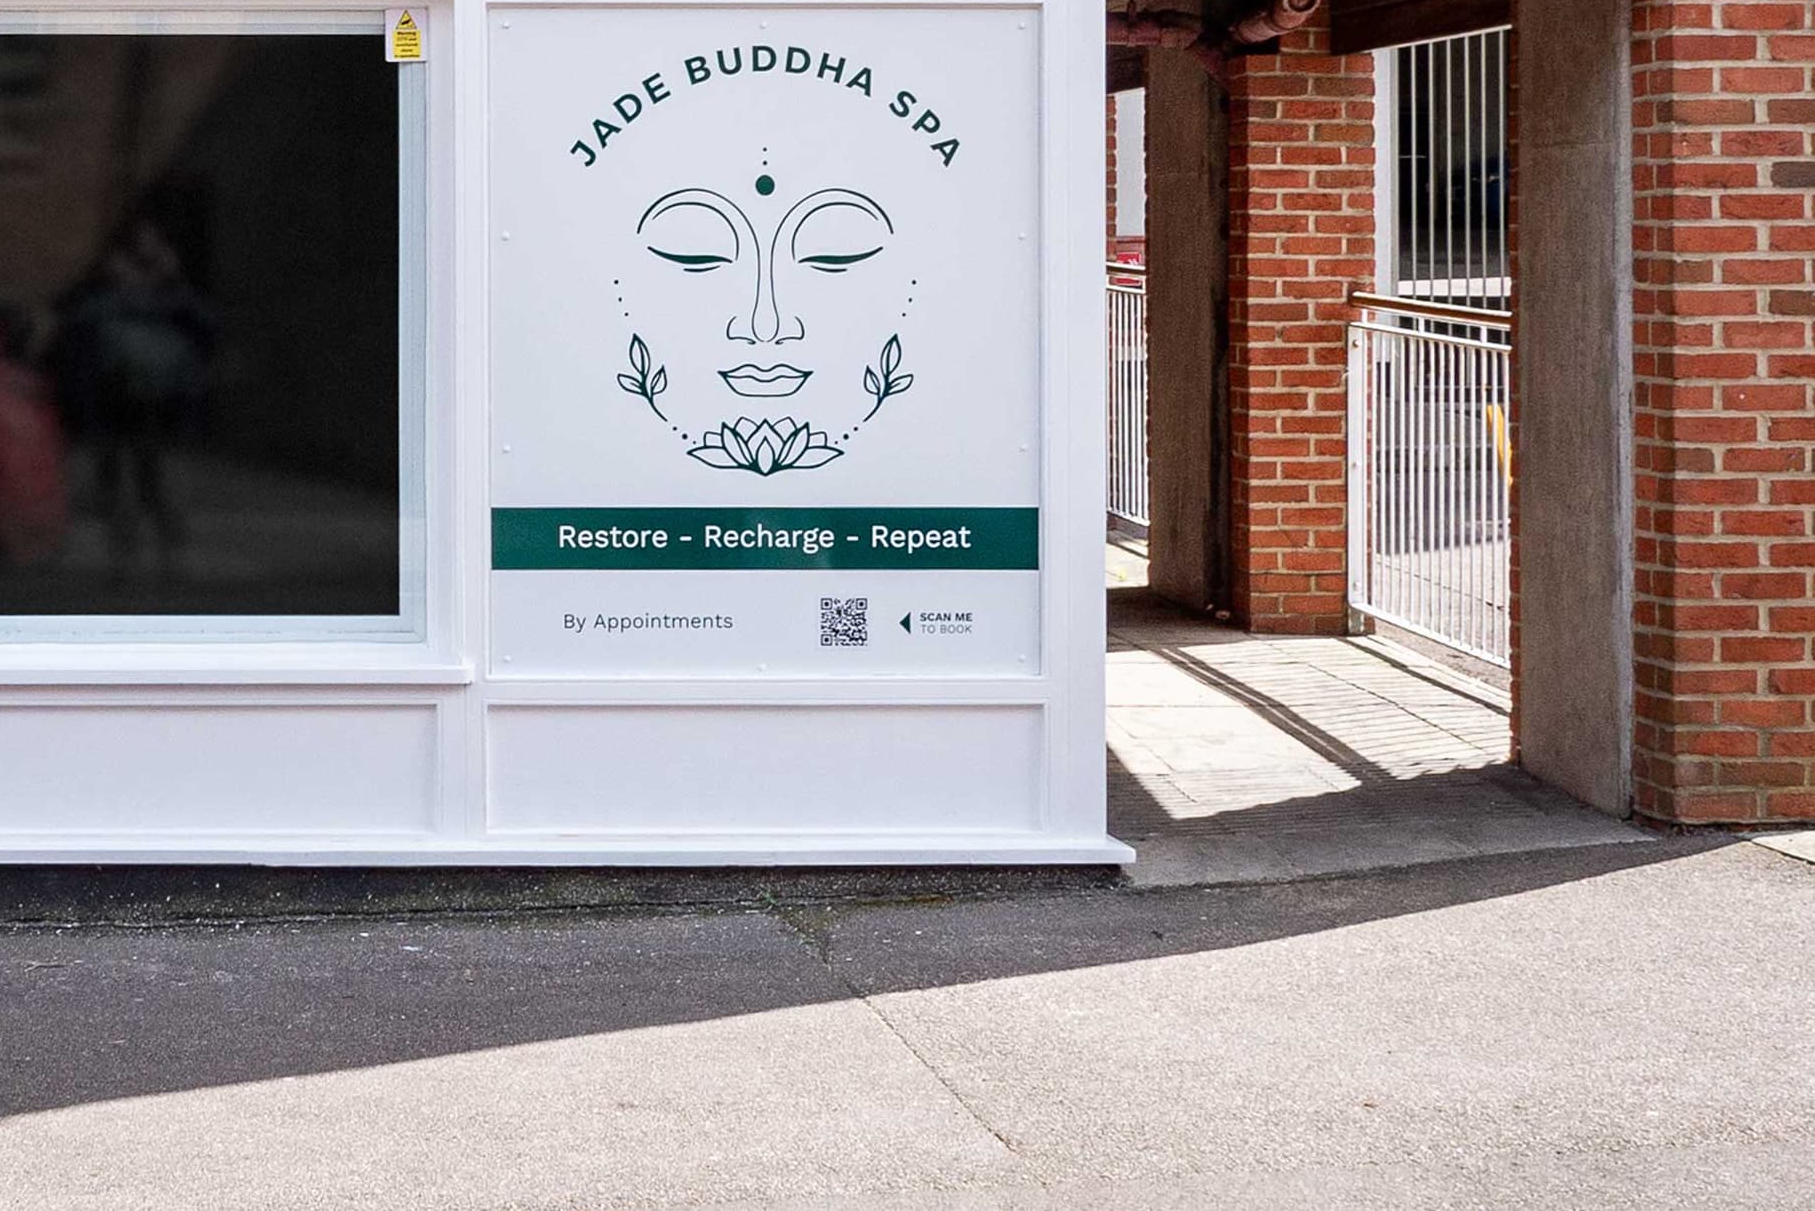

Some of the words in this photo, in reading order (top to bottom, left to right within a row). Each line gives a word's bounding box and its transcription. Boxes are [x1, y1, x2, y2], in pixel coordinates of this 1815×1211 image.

[569, 72, 671, 167] JADE
[684, 45, 873, 98] BUDDHA
[888, 90, 961, 168] SPA
[558, 524, 668, 549] Restore
[704, 523, 836, 553] Recharge
[871, 524, 972, 553] Repeat
[563, 613, 587, 634] By
[593, 611, 734, 634] Appointments
[919, 612, 952, 622] SCAN
[954, 612, 974, 622] ME
[920, 623, 936, 635] TO
[939, 623, 973, 635] BOOK
